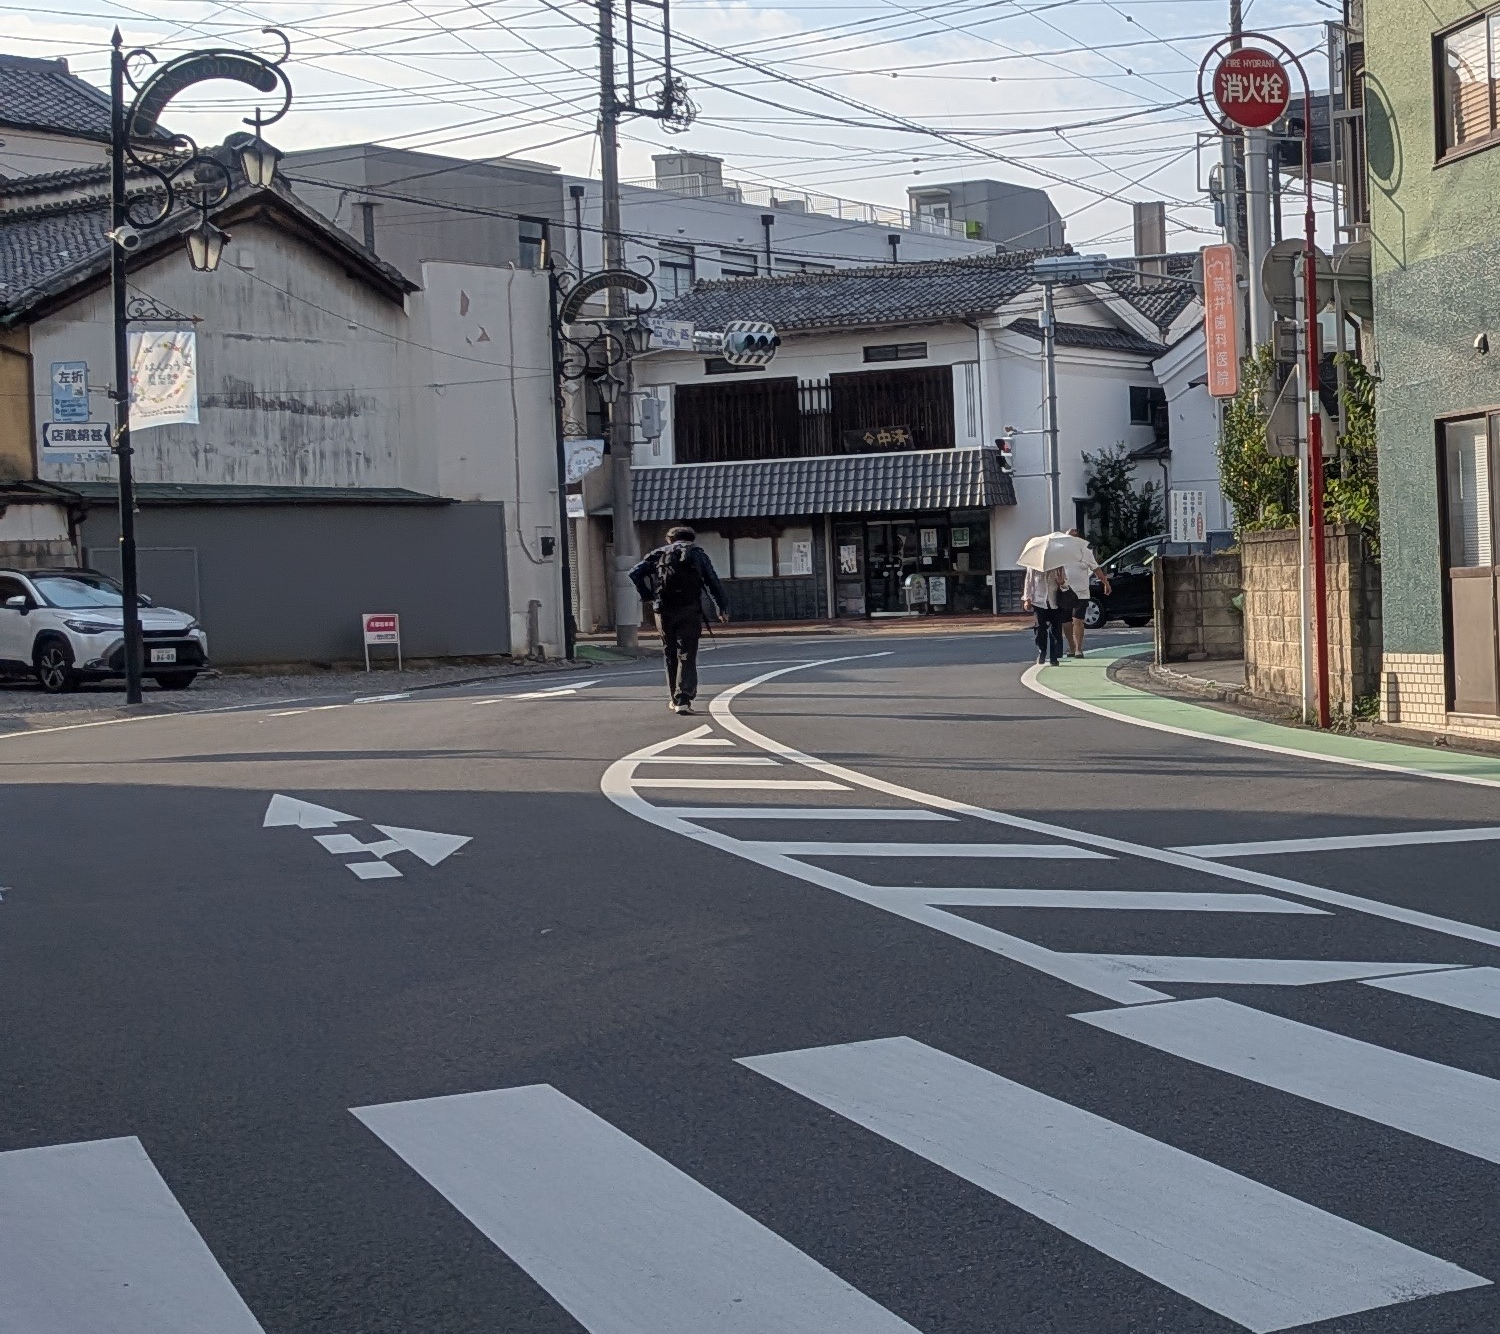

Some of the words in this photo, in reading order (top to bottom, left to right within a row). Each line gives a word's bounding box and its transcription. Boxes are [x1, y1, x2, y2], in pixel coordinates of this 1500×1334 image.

[1225, 58, 1242, 68] FIRE
[1243, 58, 1275, 68] HYDRANT
[1221, 72, 1284, 104] 消火栓
[58, 370, 84, 384] 左折
